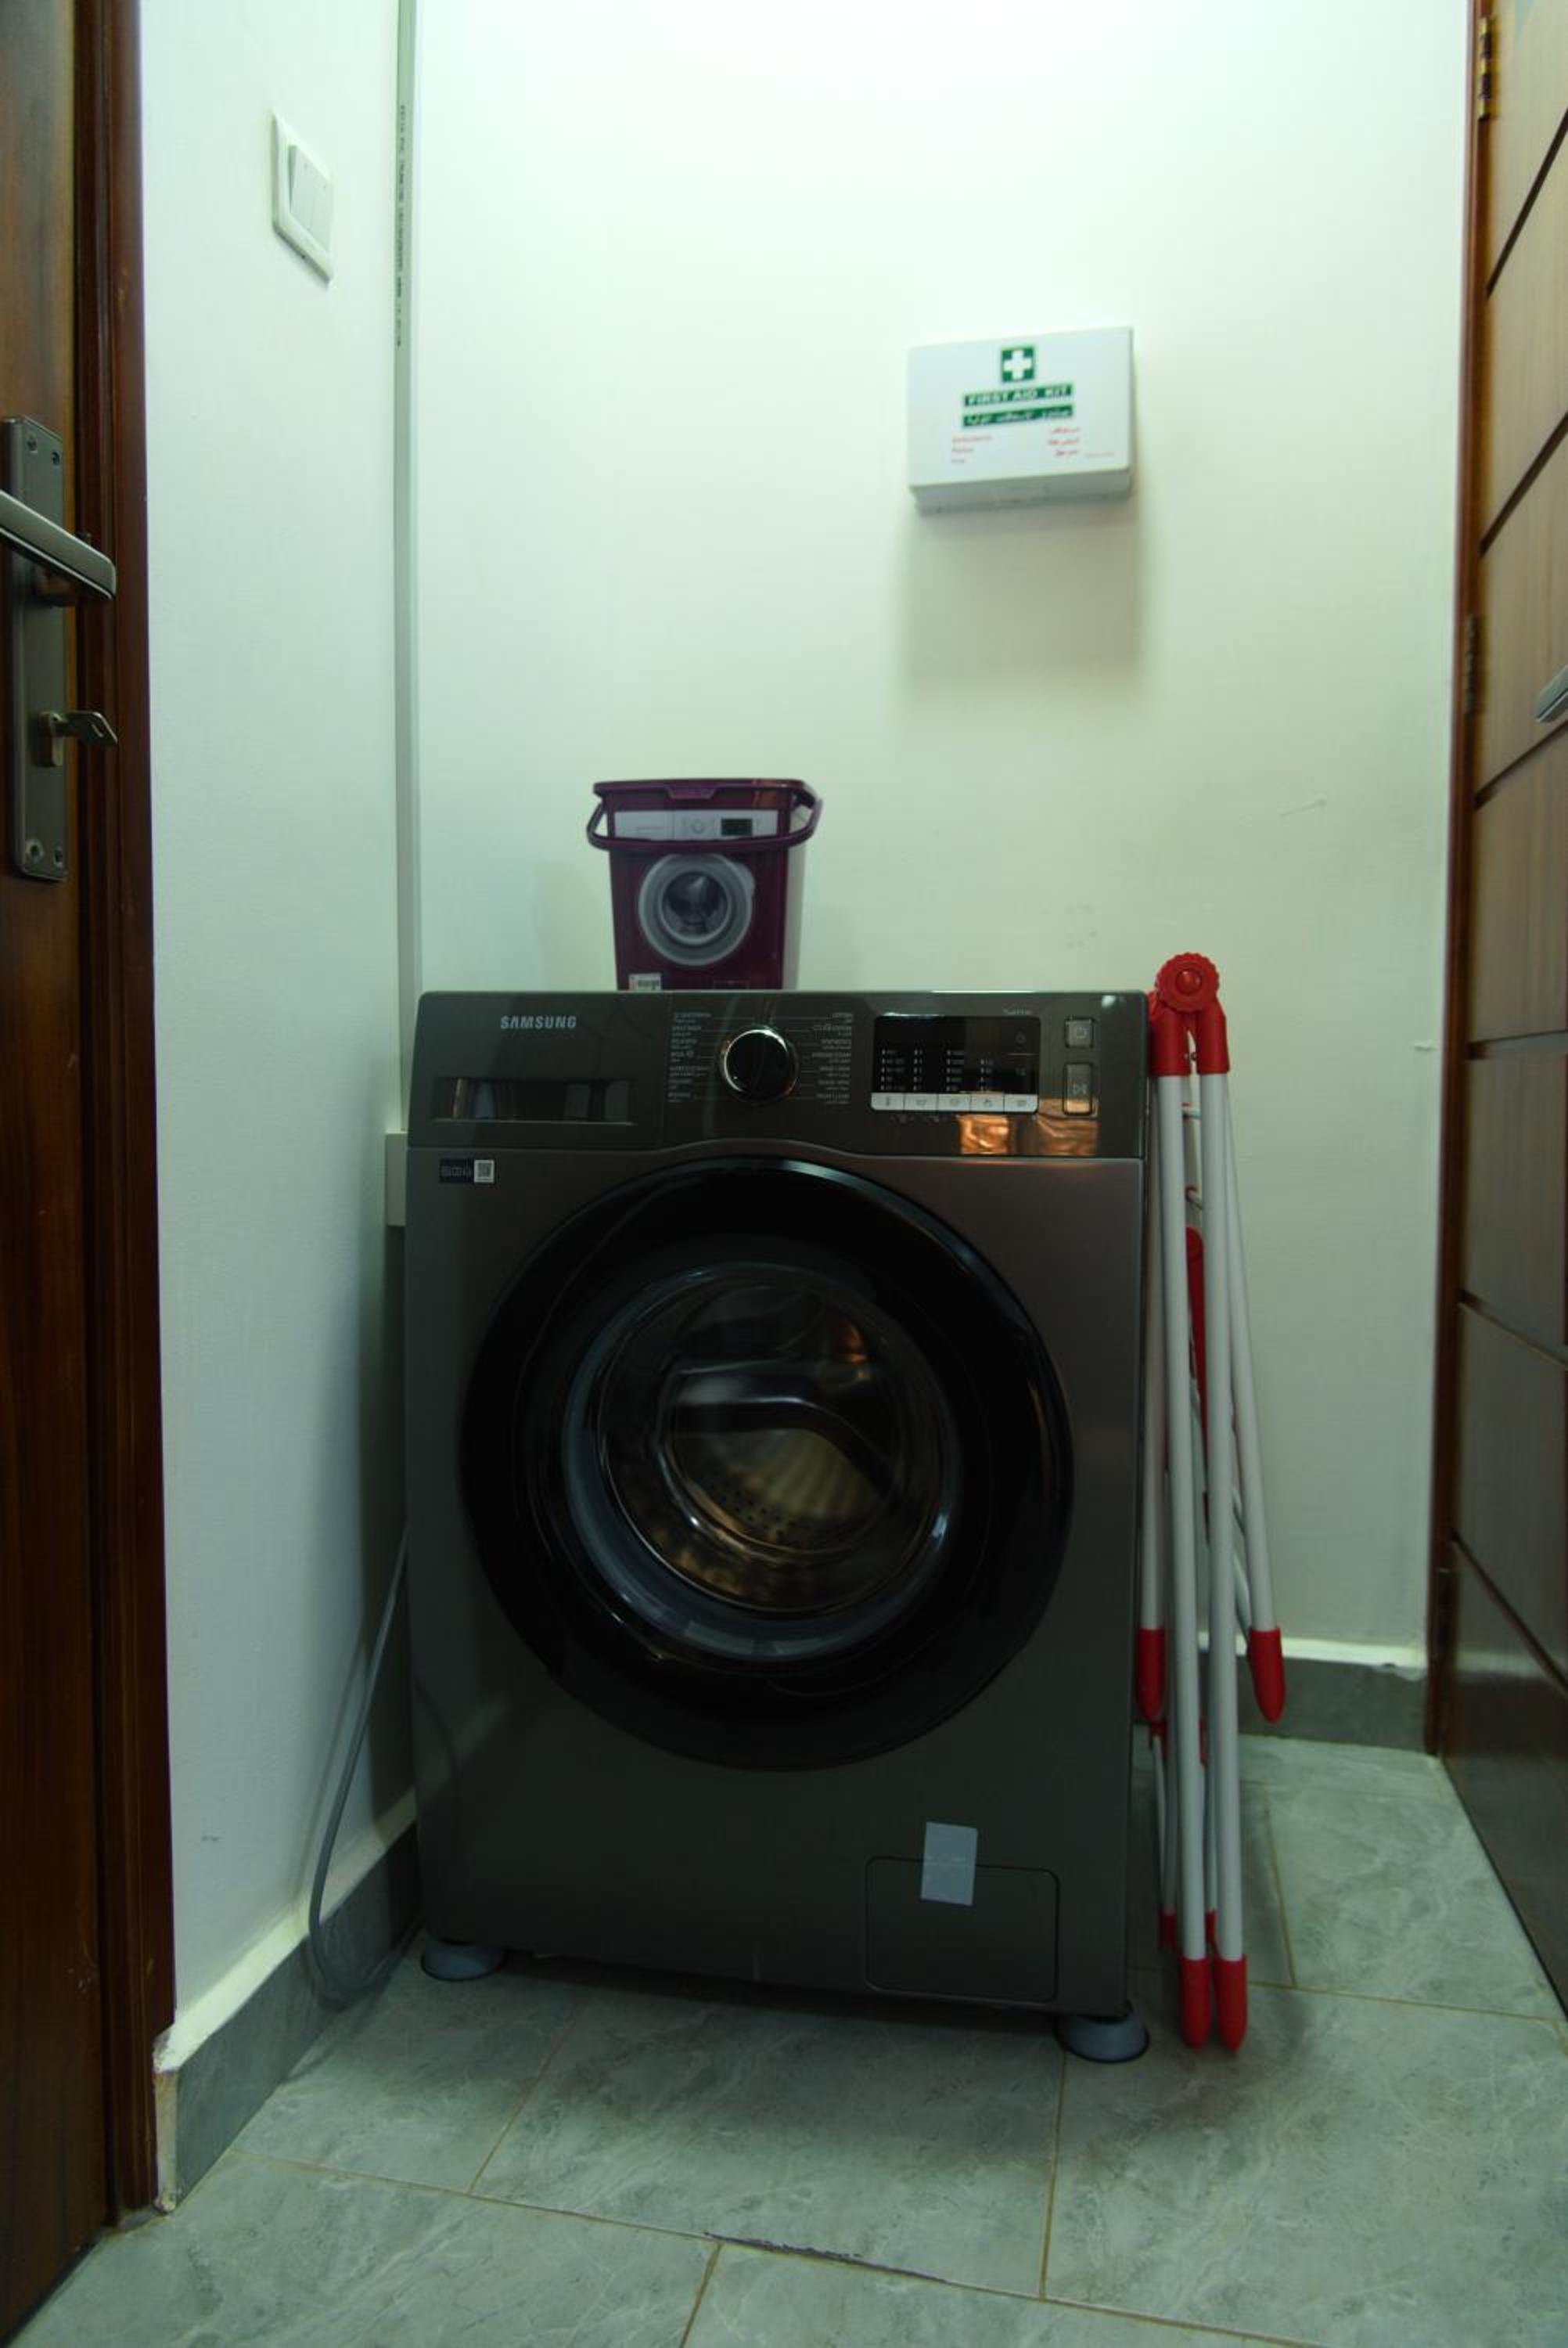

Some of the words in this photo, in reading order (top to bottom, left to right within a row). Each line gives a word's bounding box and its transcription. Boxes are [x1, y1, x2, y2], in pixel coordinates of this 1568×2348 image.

[967, 392, 1009, 405] FIRST
[1012, 389, 1038, 402] AID
[1043, 387, 1068, 398] KIT
[500, 1015, 577, 1029] SAMSUNG
